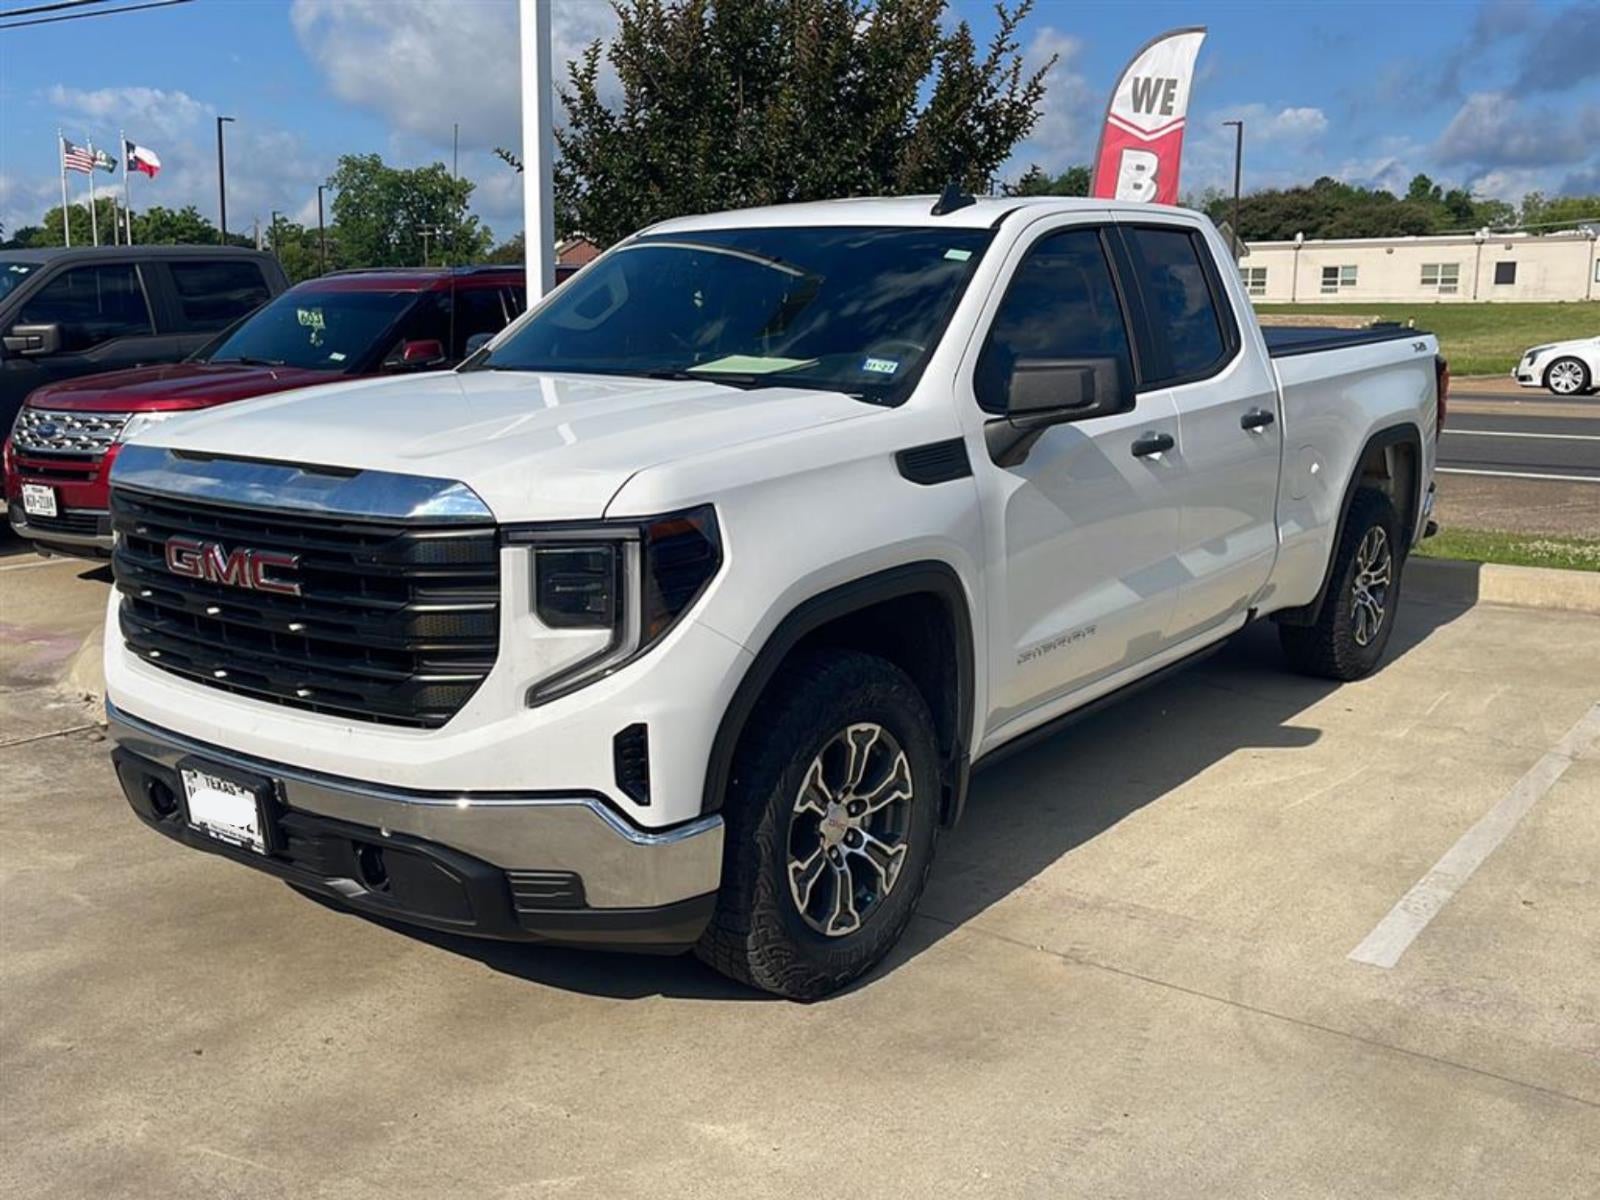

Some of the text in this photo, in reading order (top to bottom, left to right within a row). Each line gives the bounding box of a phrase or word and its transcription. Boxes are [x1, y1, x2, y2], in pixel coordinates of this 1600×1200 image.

[1131, 76, 1178, 116] WE
[1115, 148, 1159, 203] B
[164, 535, 302, 597] GMC
[205, 775, 237, 796] TEXAS
